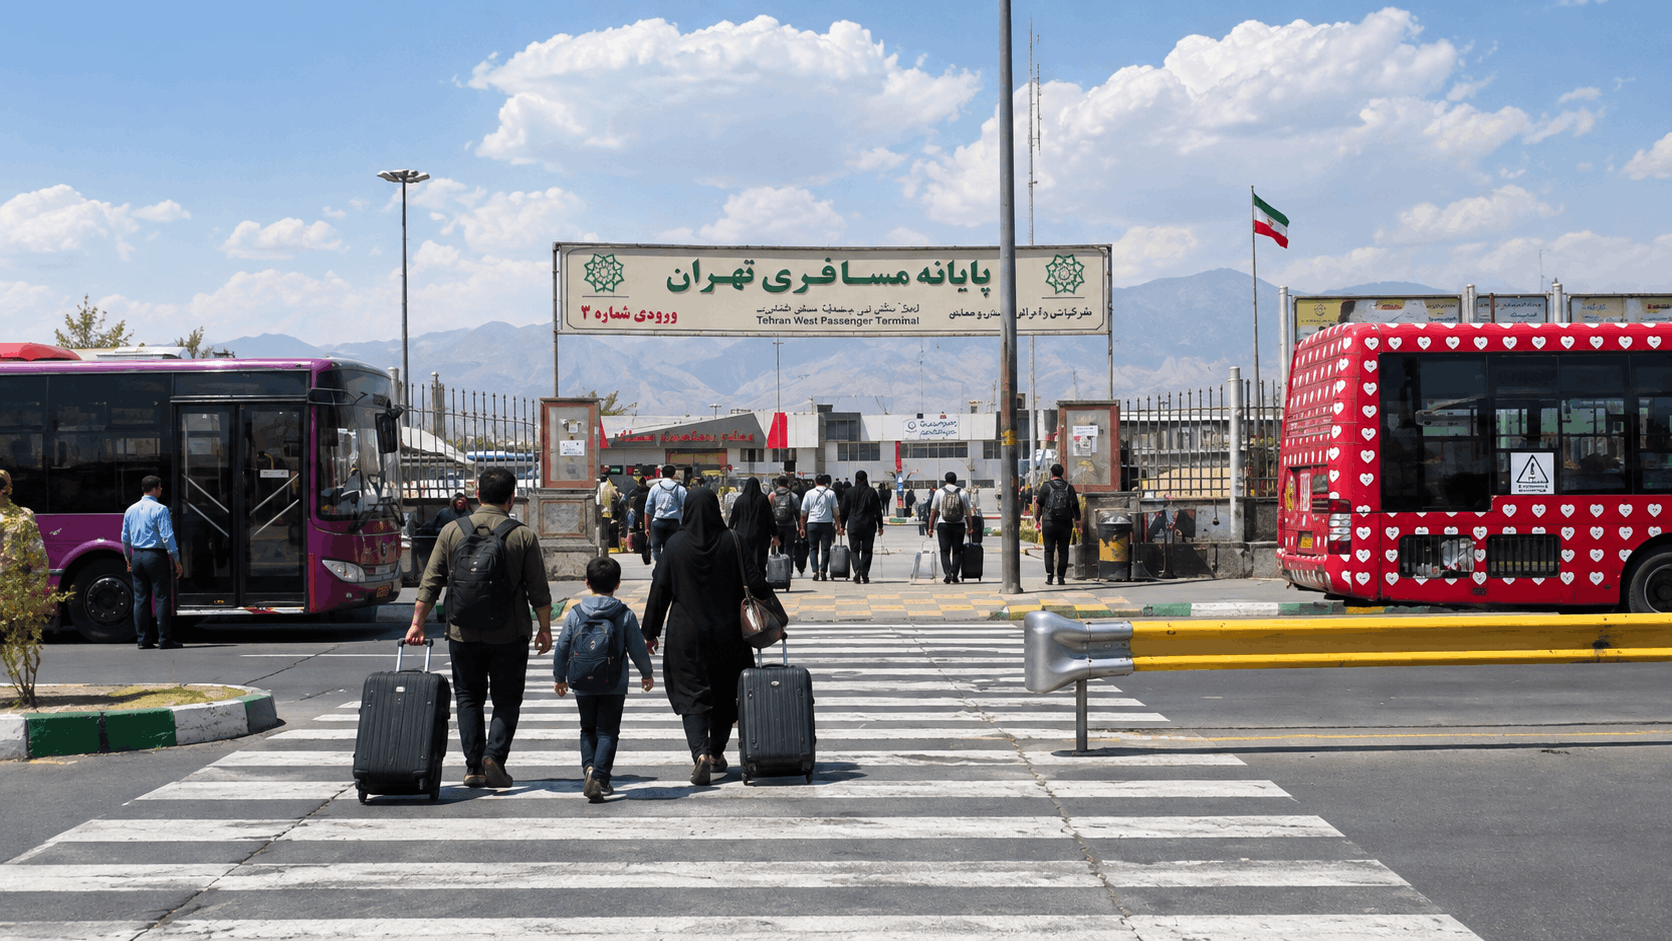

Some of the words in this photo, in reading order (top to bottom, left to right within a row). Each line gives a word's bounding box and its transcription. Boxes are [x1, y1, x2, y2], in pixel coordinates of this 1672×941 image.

[666, 258, 755, 293] تهران
[761, 257, 910, 294] مسافری
[916, 259, 992, 296] پایانه
[594, 305, 631, 324] شماره
[633, 309, 678, 325] ورودی
[756, 315, 792, 325] Tehran
[793, 315, 818, 325] West
[820, 315, 874, 328] Passenger
[875, 315, 920, 325] Terminal
